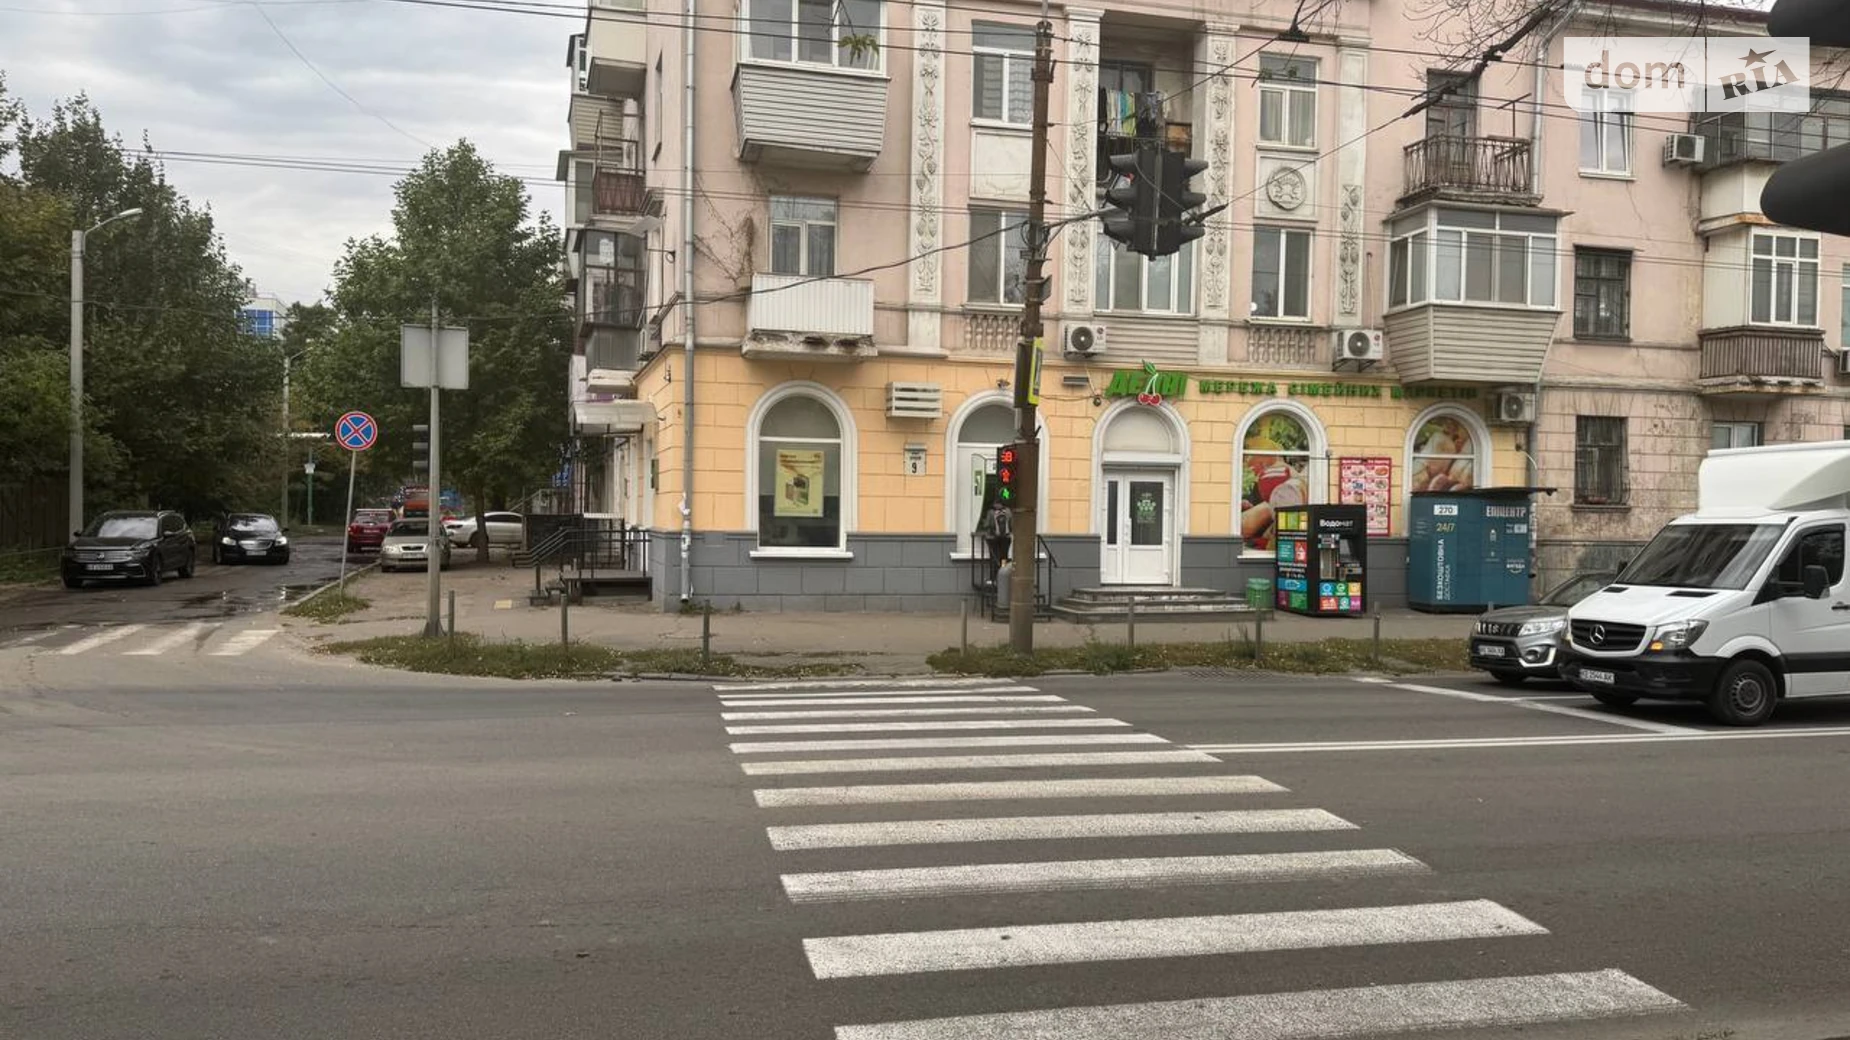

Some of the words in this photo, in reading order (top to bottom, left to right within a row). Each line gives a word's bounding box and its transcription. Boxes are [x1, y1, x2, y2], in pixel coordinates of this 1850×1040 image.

[1199, 380, 1278, 395] МЕРЕЖА
[1288, 382, 1381, 397] СІМЕЙНИХ
[911, 462, 917, 473] 9
[1486, 506, 1526, 517] ЕПІЦЕНТР
[1436, 522, 1455, 532] 24/7
